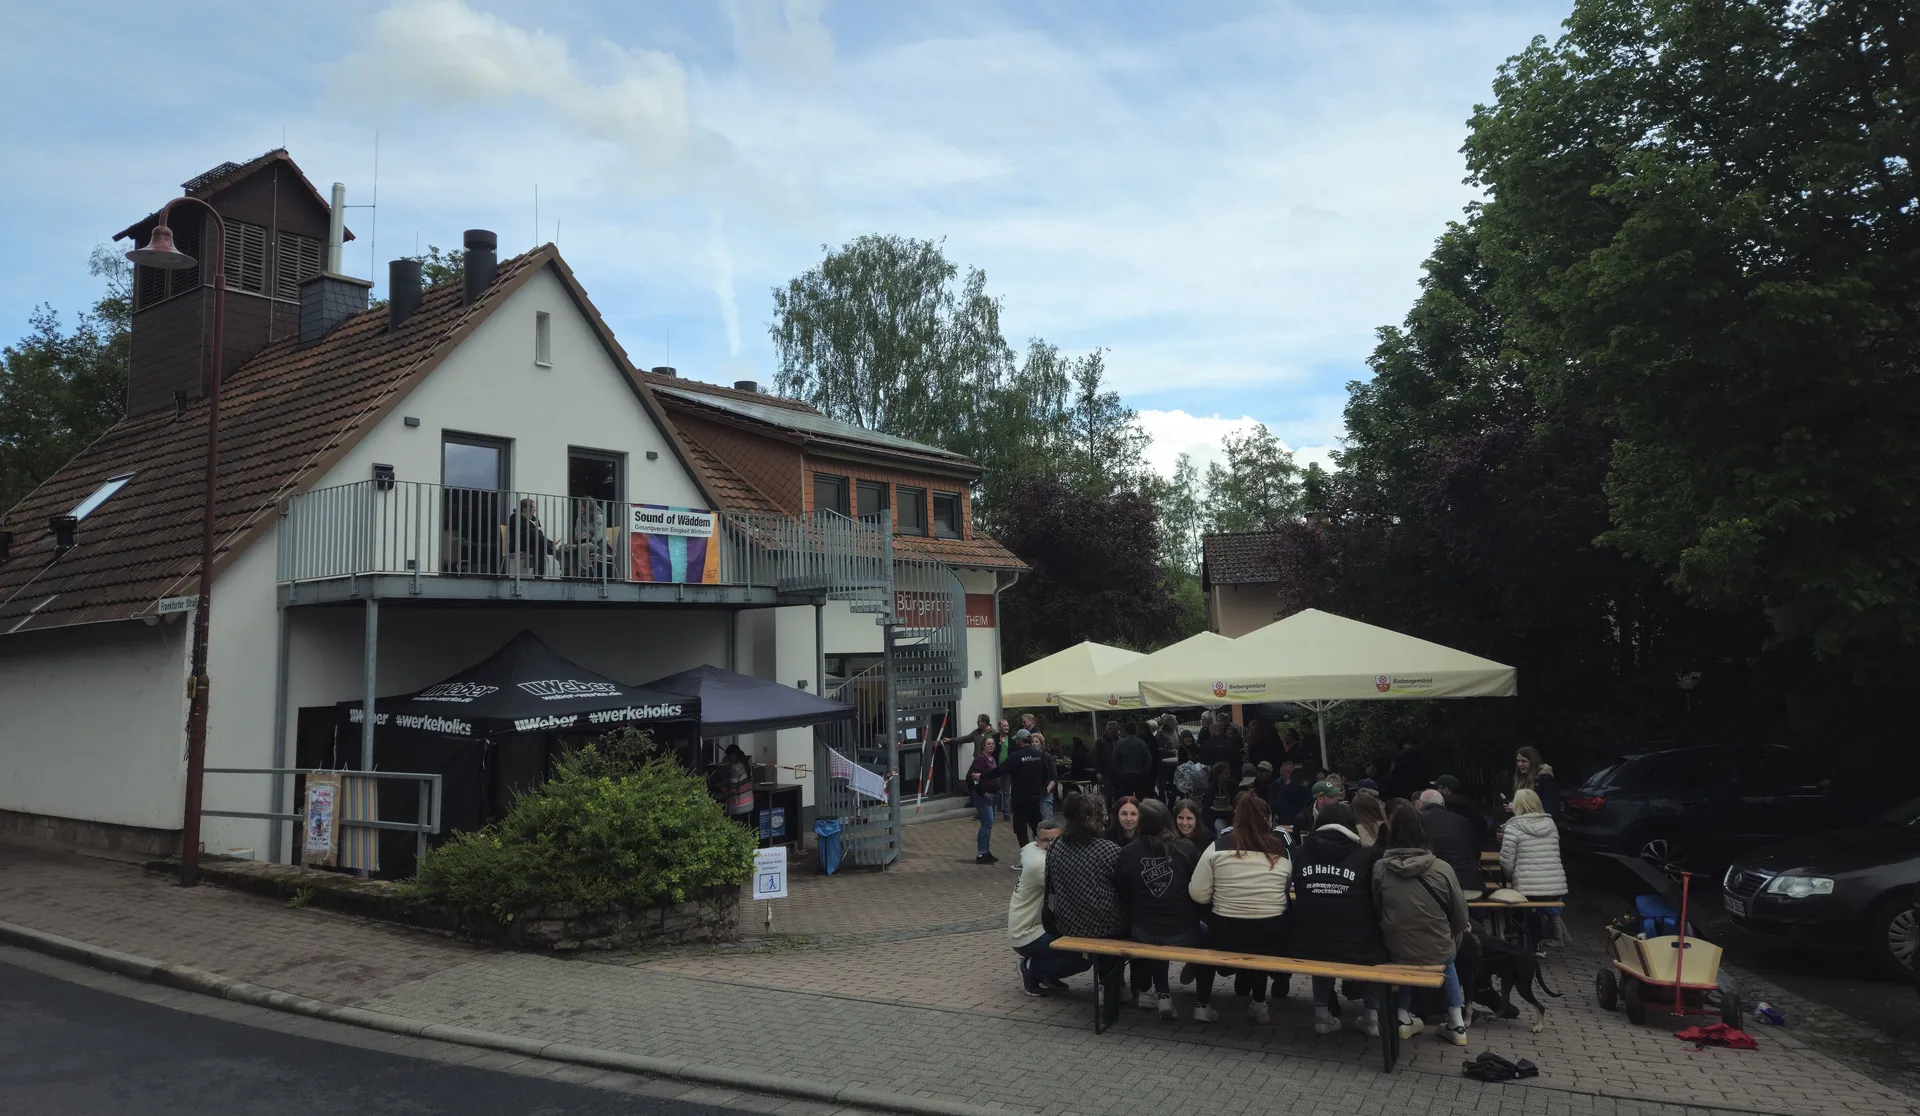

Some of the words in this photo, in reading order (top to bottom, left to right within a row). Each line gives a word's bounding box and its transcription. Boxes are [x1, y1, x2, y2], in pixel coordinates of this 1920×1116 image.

[634, 510, 664, 524] Sound
[666, 514, 676, 525] of
[678, 514, 711, 527] Wäddem
[634, 523, 669, 532] Gesangverein
[670, 526, 690, 534] Einigkeit
[160, 600, 185, 611] Frankfurter
[516, 679, 617, 696] Weber
[541, 691, 623, 701] weber-werke.de
[395, 713, 472, 736] #werkeholics
[514, 714, 578, 733] Weber
[588, 703, 682, 724] #werkeholics
[1302, 865, 1313, 877] SG
[1315, 864, 1341, 876] Haitz
[1343, 868, 1356, 881] 08
